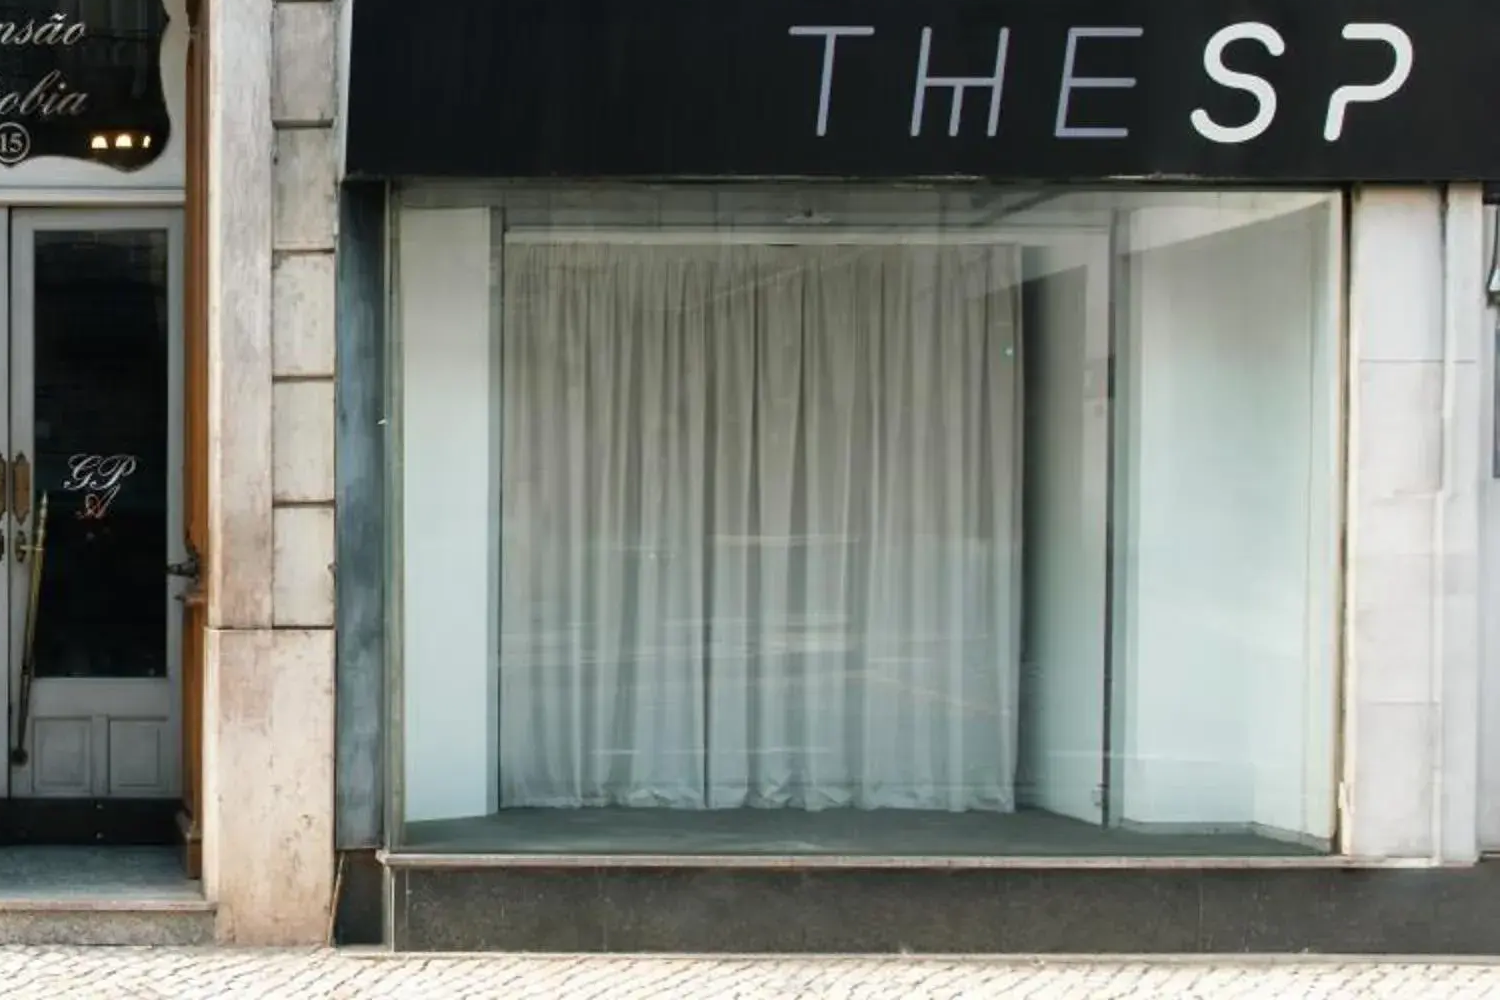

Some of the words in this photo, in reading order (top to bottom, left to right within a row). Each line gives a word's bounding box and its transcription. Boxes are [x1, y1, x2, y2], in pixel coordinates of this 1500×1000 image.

[788, 25, 1144, 138] THE
[1190, 21, 1414, 143] SP
[0, 132, 24, 154] 15
